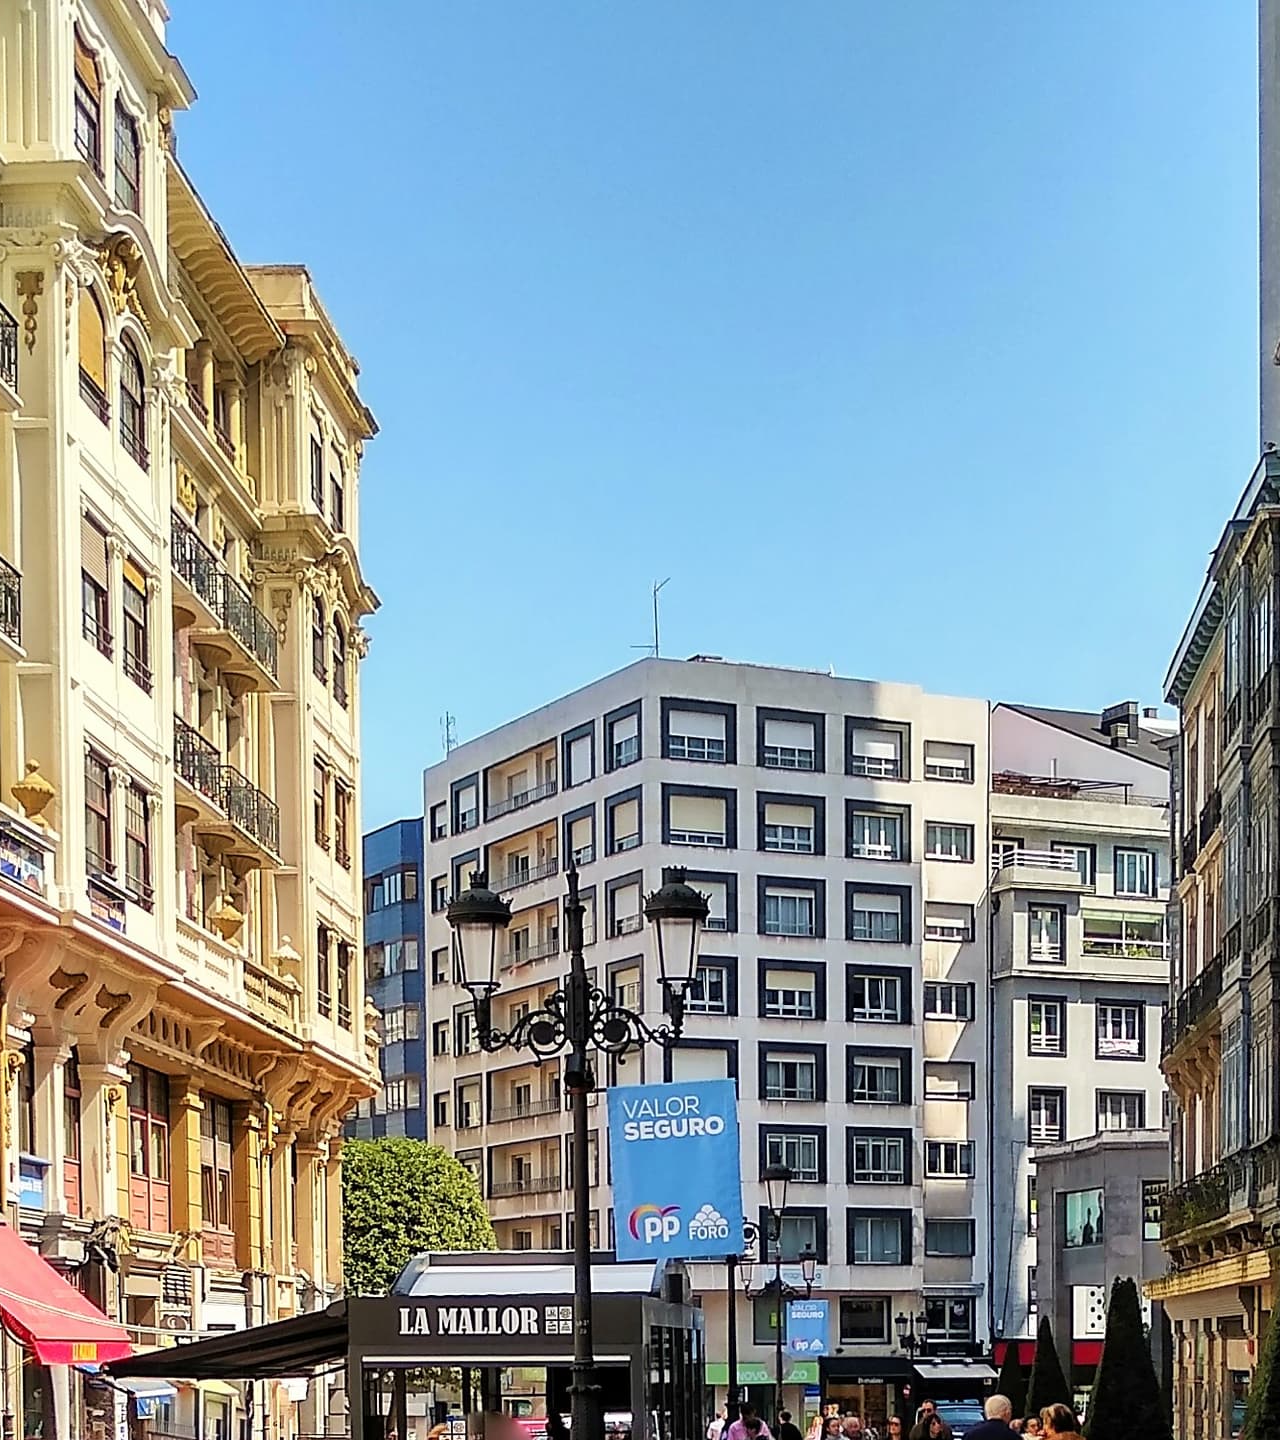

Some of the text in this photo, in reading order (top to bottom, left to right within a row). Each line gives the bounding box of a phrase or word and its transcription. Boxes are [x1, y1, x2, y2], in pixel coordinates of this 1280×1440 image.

[622, 1095, 700, 1119] VALOR
[623, 1115, 725, 1142] SEGURO
[689, 1224, 730, 1241] FORO
[399, 1307, 431, 1335] LA
[437, 1306, 539, 1335] MALLOR
[791, 1311, 824, 1320] SEGURO
